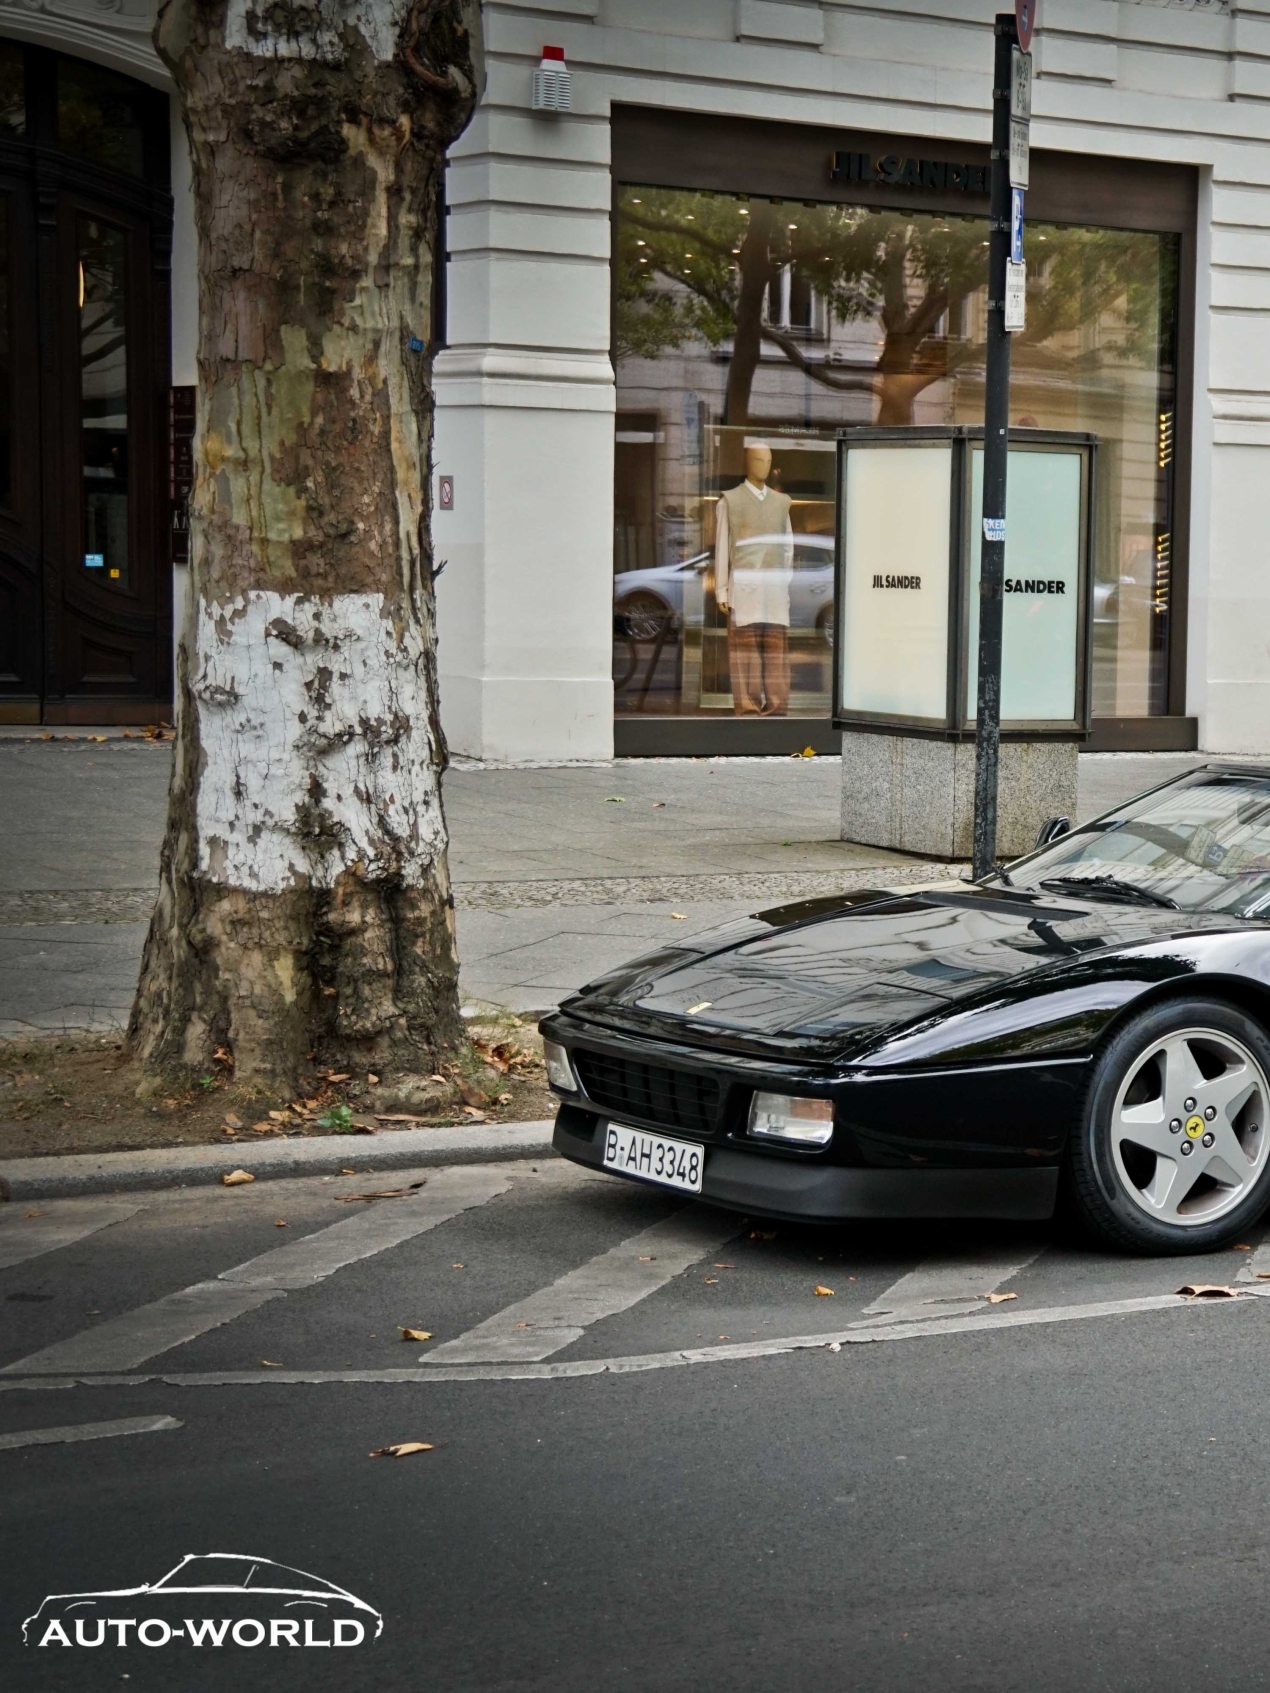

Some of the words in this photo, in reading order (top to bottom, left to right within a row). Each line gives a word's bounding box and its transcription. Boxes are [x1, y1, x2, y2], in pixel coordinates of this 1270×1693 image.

[831, 151, 876, 181] JIL
[877, 155, 993, 192] SANDE
[872, 575, 884, 589] JIL
[885, 575, 921, 590] SANDER
[1004, 579, 1066, 594] SANDER
